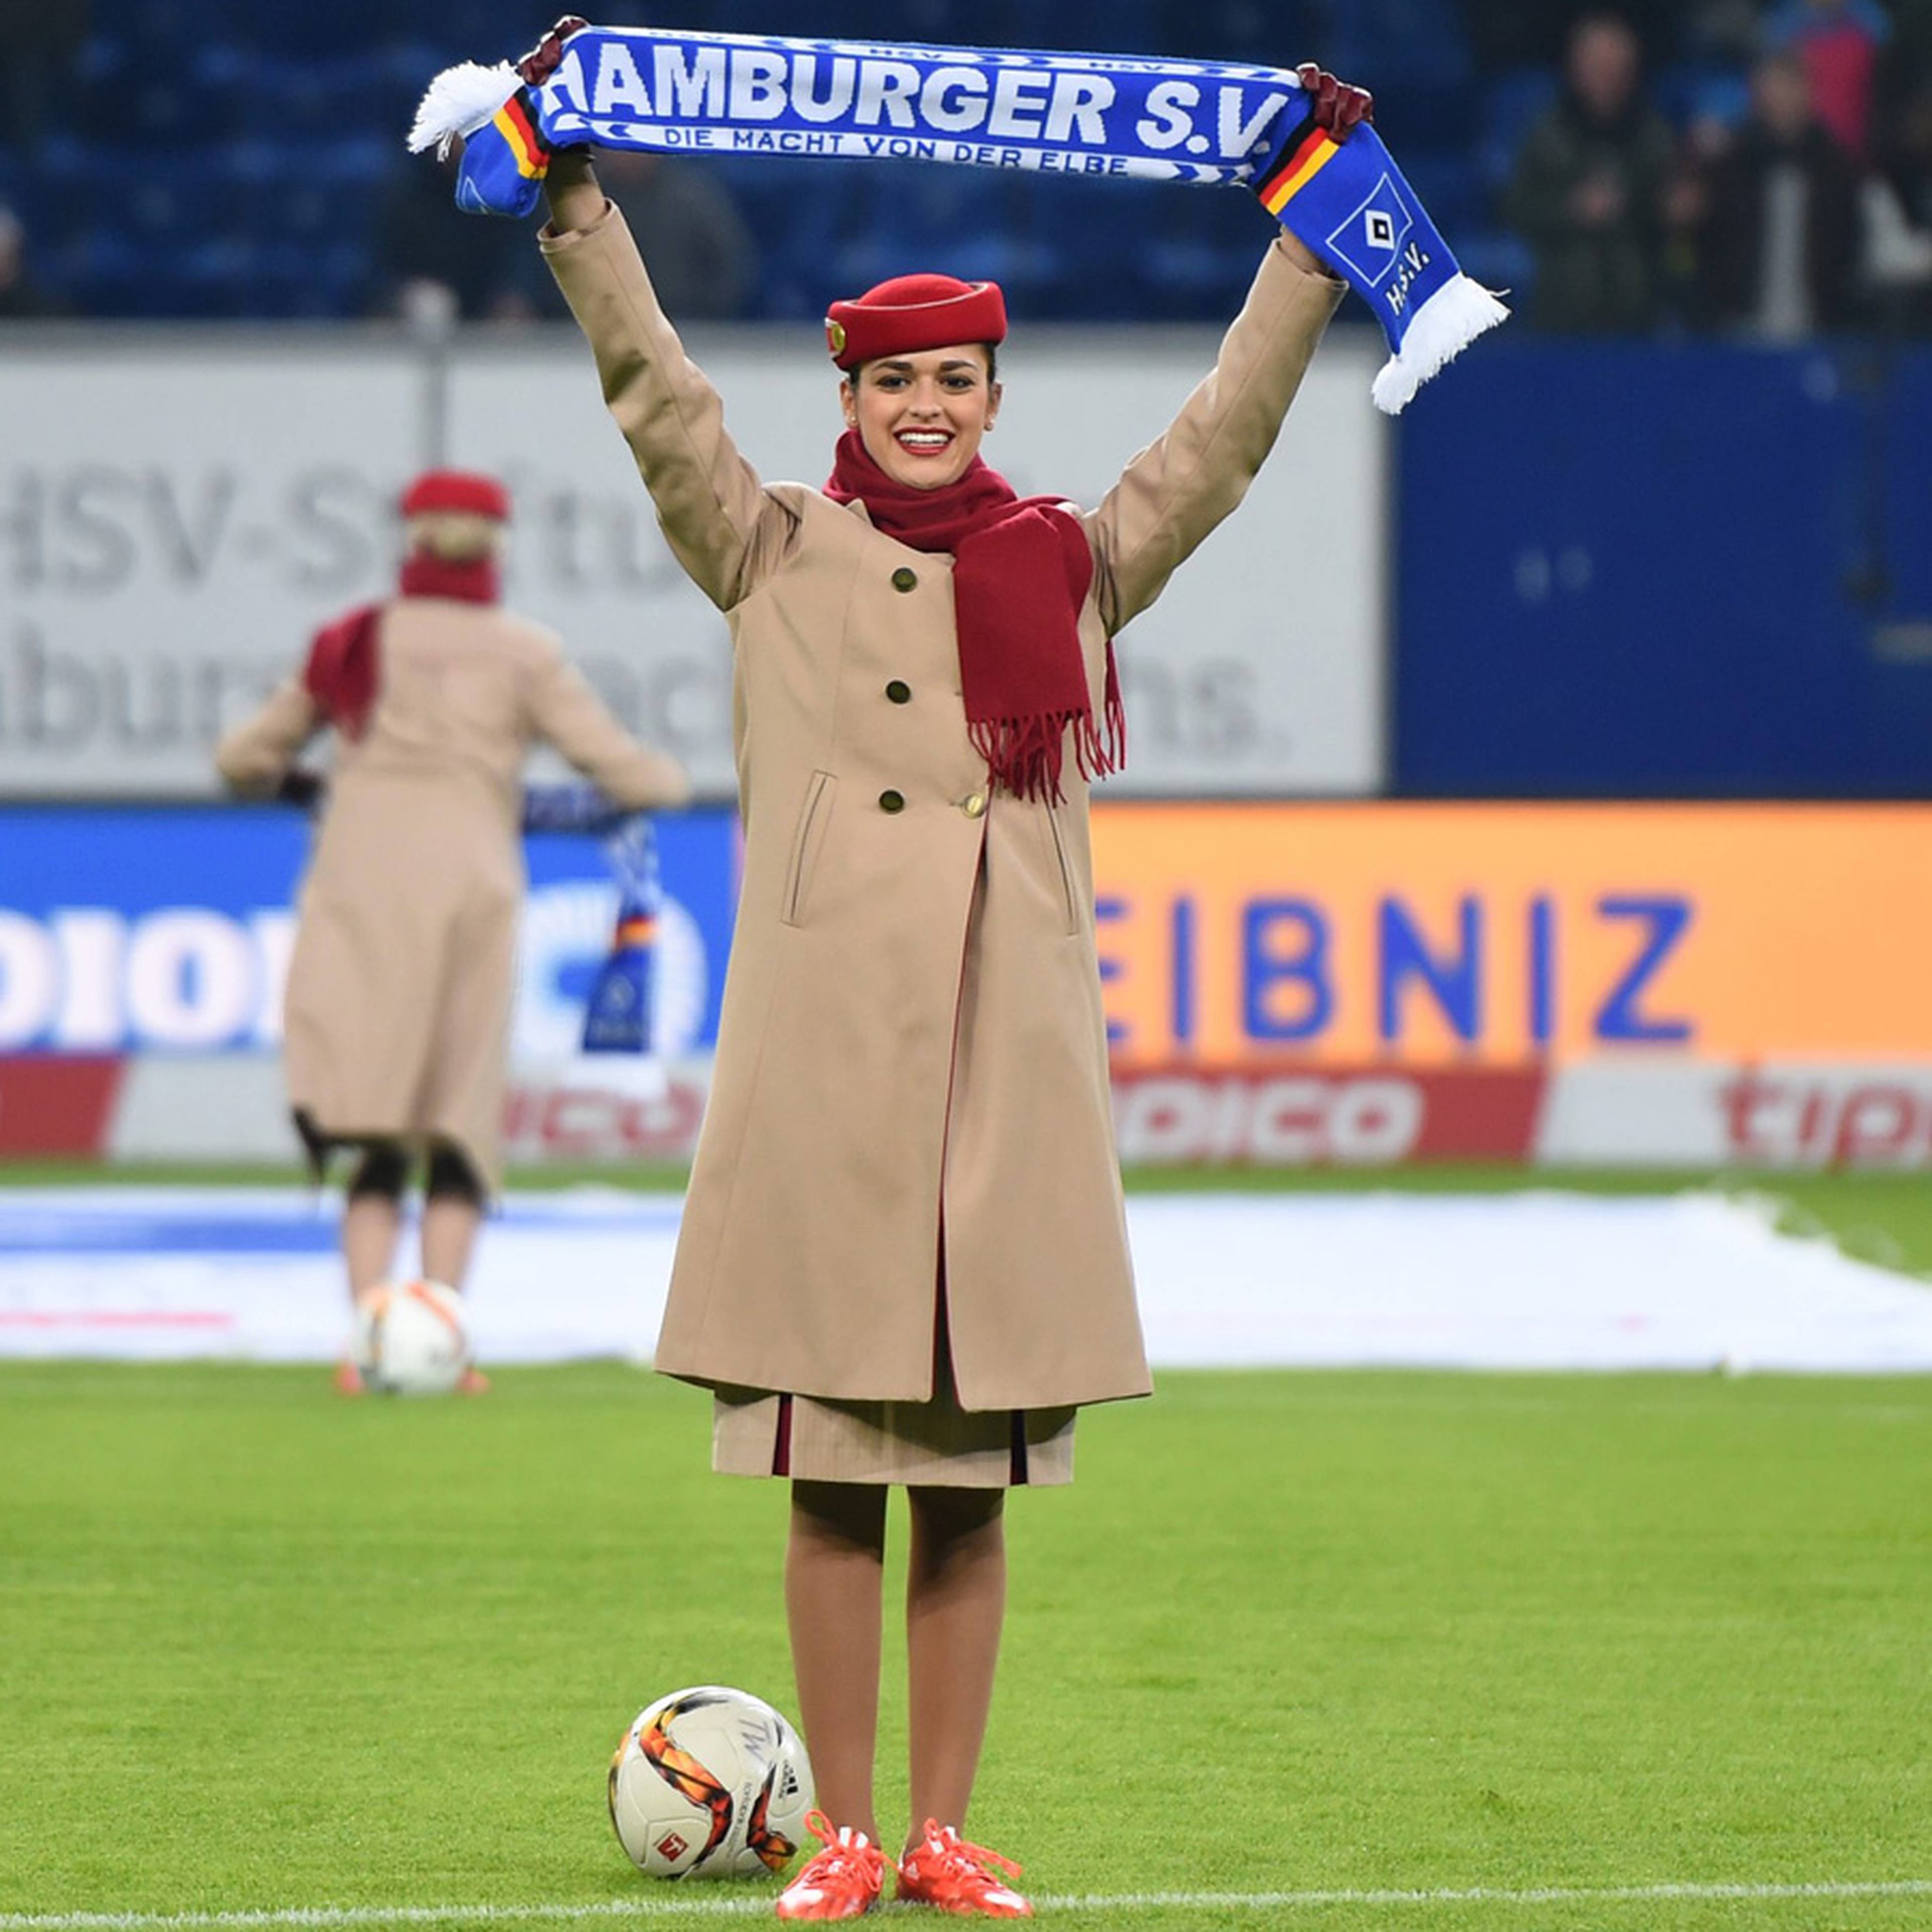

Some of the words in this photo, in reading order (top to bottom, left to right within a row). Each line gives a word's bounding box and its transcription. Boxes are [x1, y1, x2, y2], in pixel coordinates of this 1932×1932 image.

[664, 128, 713, 147] DIE
[733, 130, 844, 152] MACHT
[863, 136, 936, 158] VON
[954, 144, 1022, 167] DER
[1039, 151, 1129, 176] ELBE
[1136, 80, 1289, 158] S.V.
[1385, 242, 1430, 316] H.S.V.
